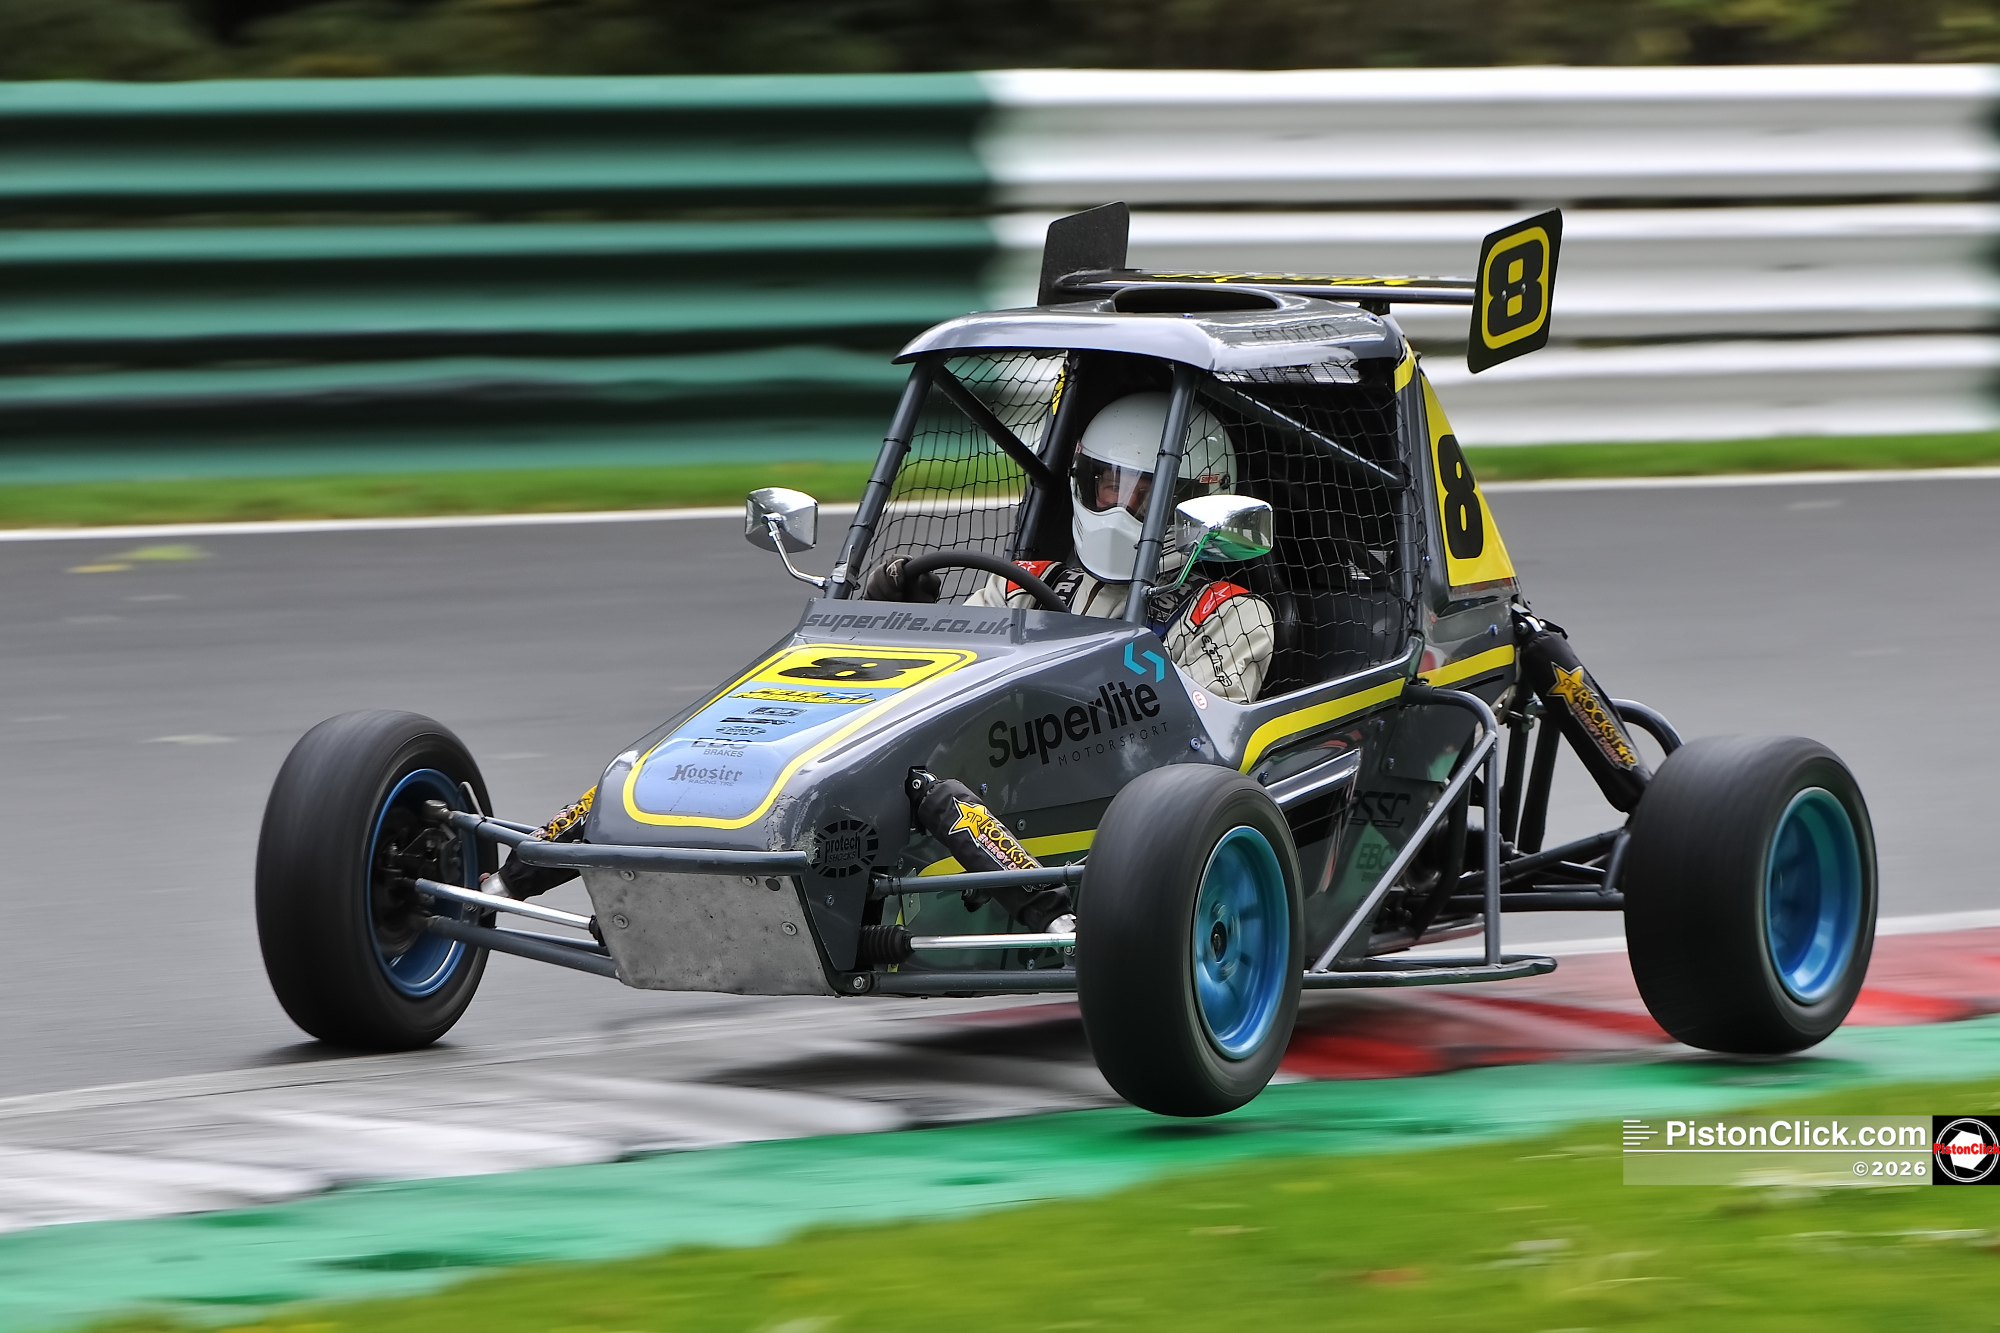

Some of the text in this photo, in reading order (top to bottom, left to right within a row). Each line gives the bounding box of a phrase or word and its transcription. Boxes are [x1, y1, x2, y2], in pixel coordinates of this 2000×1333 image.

[1487, 239, 1543, 337] 8
[1438, 434, 1484, 560] 8
[804, 611, 1013, 636] superlite.co.uk
[778, 656, 936, 682] 8
[988, 681, 1160, 769] Superlite
[703, 748, 744, 758] BRAKES
[1058, 721, 1169, 767] MOTORSPORT
[667, 763, 744, 782] Hoosier
[825, 832, 860, 863] protech
[977, 833, 1012, 864] ENERGY
[980, 820, 1037, 870] ROCKST
